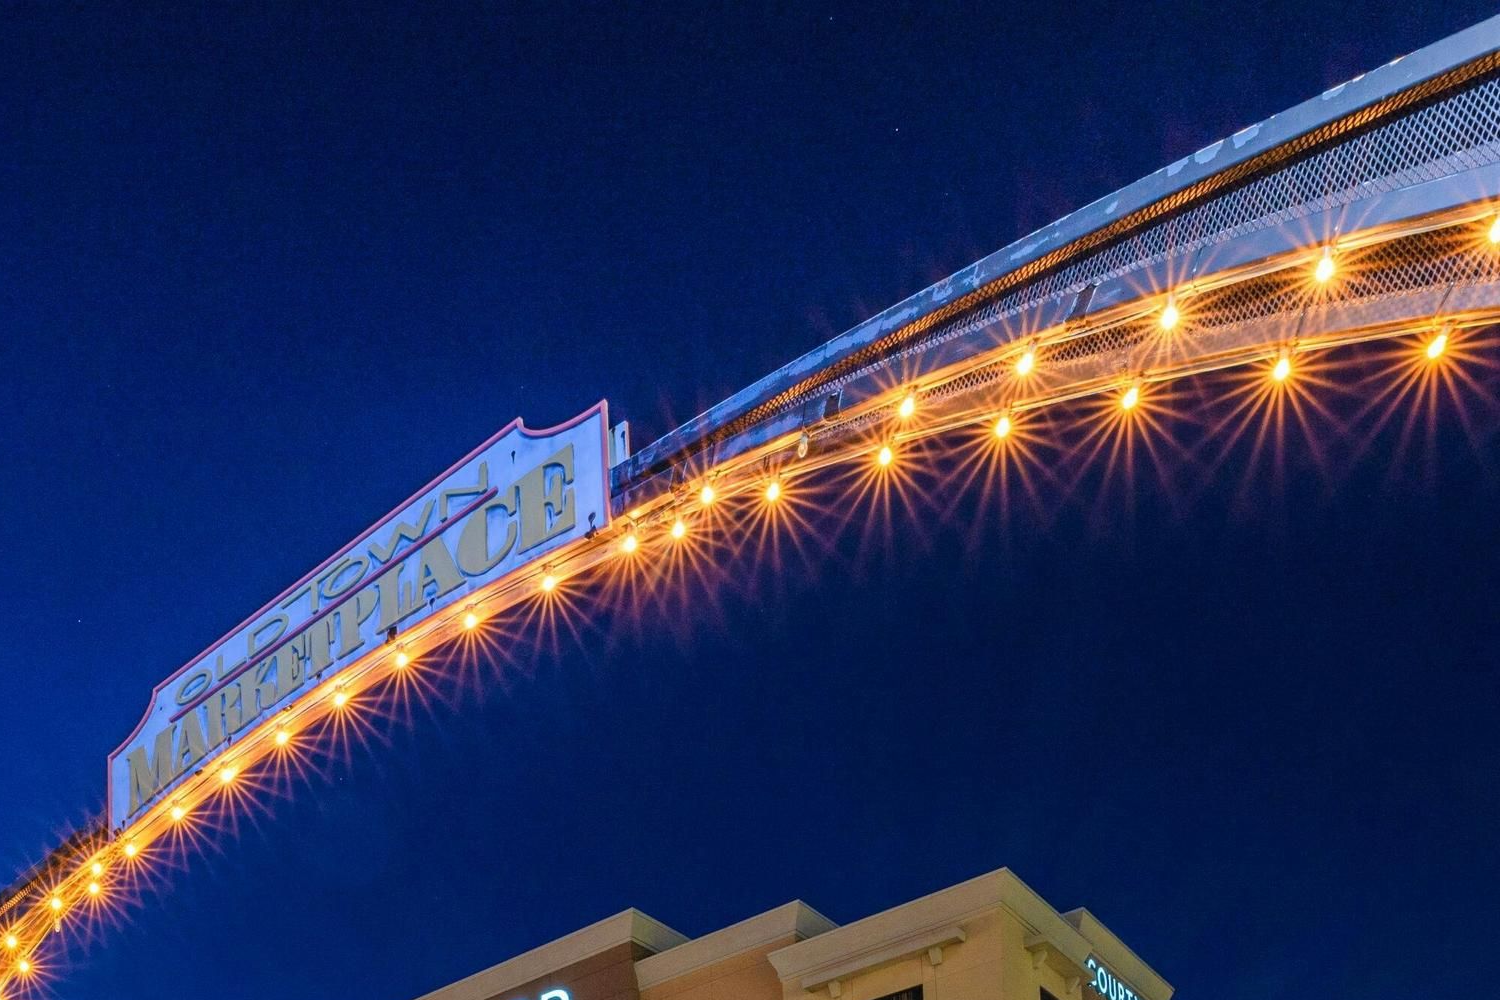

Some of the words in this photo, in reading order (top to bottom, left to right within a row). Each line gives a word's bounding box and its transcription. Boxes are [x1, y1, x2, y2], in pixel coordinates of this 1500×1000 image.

[126, 443, 576, 819] MARKETPLACE
[176, 613, 289, 706] OLD
[281, 462, 489, 613] TOWN
